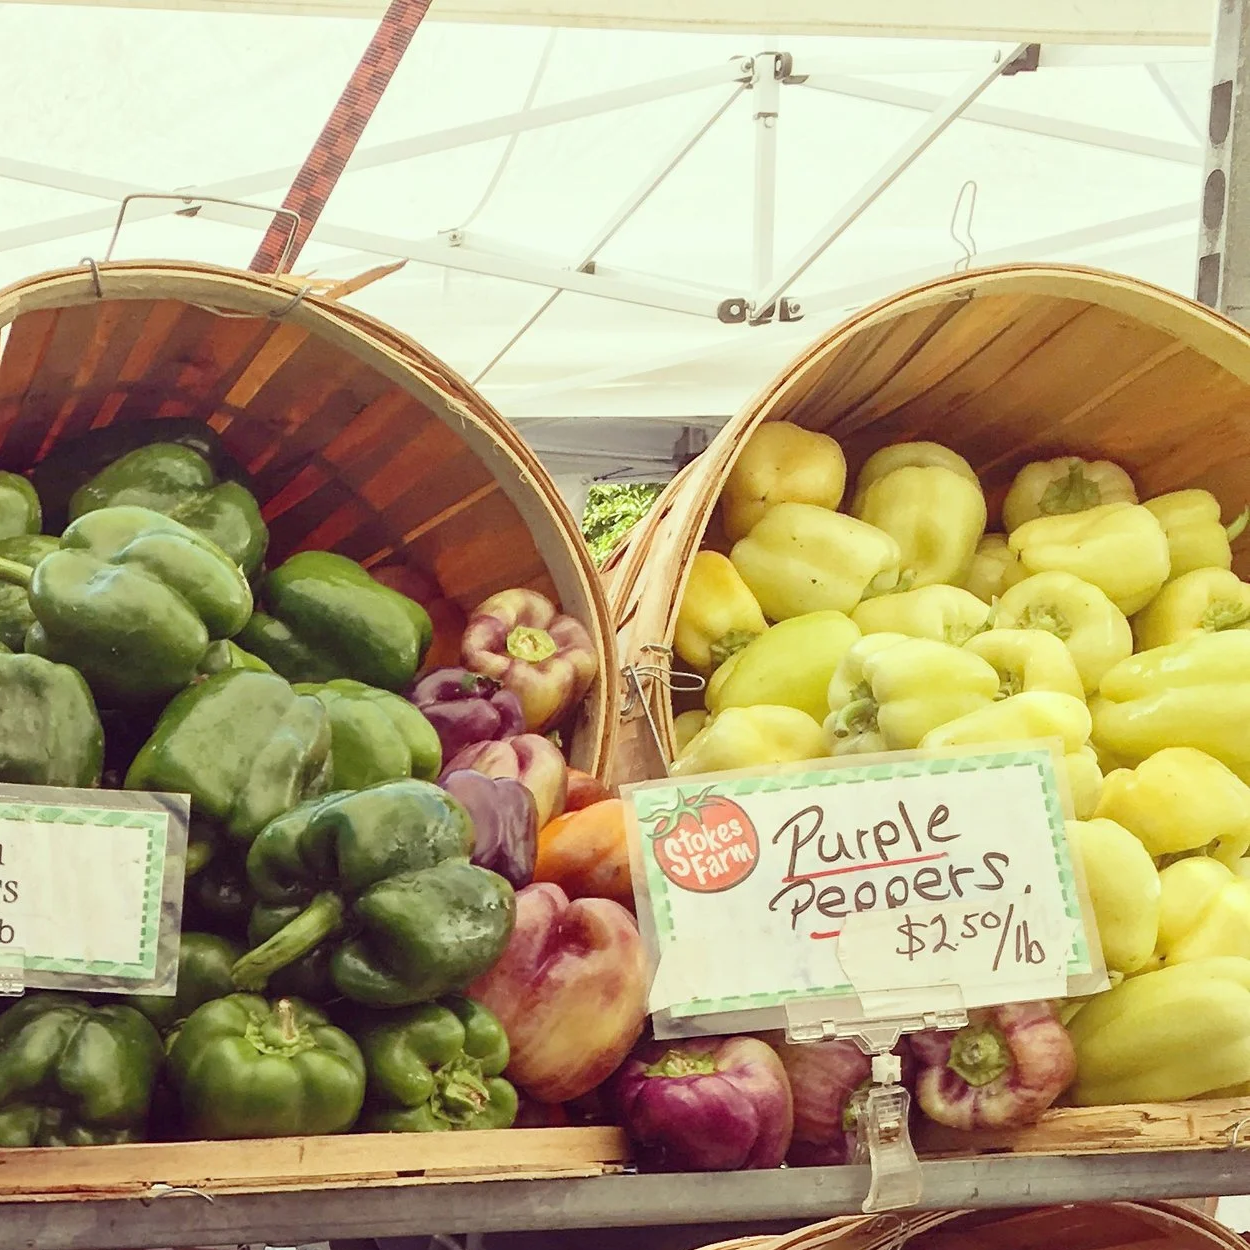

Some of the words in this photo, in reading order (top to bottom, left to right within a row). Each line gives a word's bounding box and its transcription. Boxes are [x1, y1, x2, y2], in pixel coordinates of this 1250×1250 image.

[663, 818, 744, 878] Stokes
[690, 842, 755, 886] Farm
[771, 800, 961, 877] Purple
